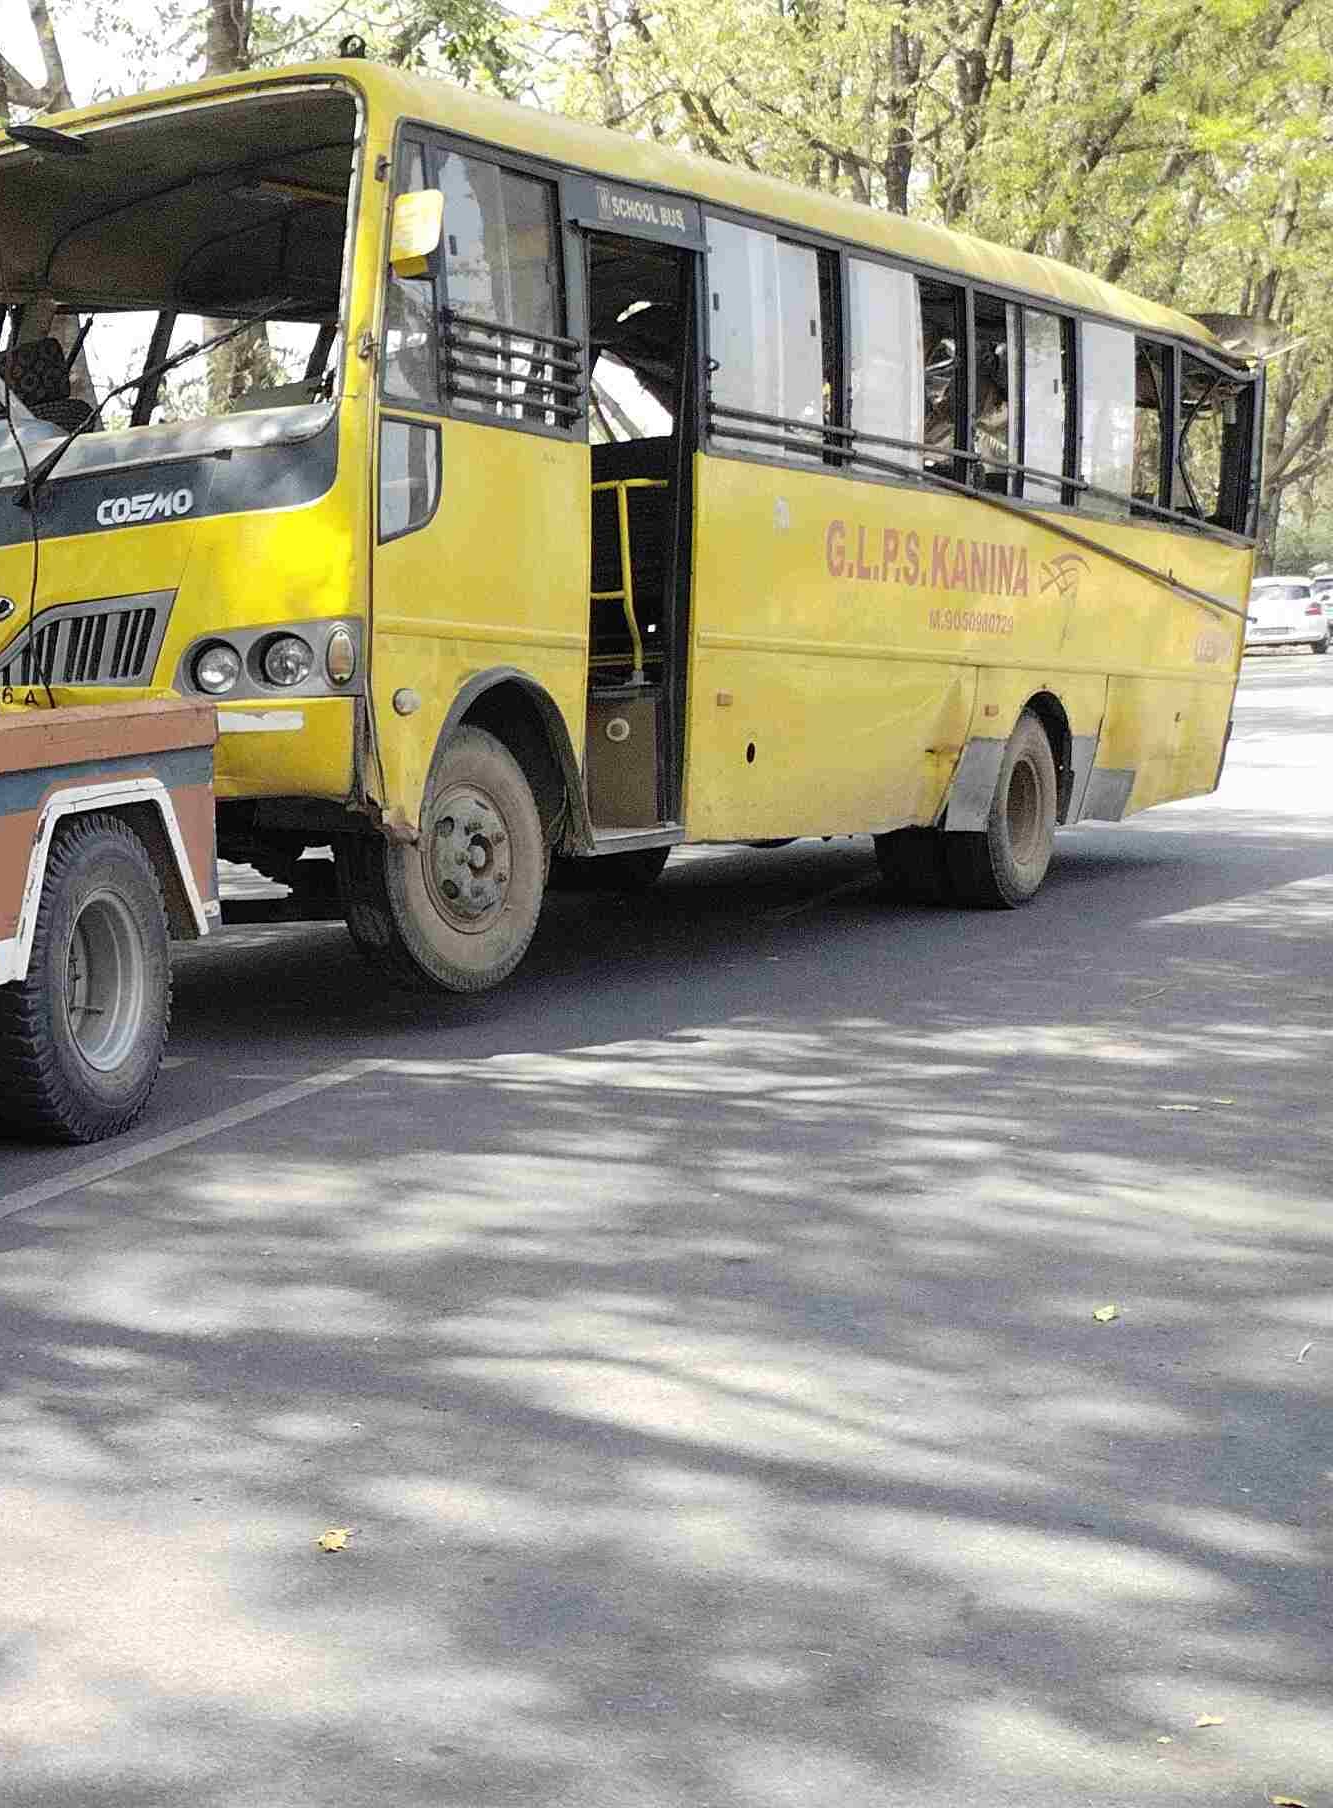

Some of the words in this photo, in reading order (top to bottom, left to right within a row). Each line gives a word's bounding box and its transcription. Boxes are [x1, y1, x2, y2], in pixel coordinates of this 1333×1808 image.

[612, 195, 659, 225] SCHOOL
[660, 206, 685, 232] BUS
[96, 488, 193, 525] COSMO
